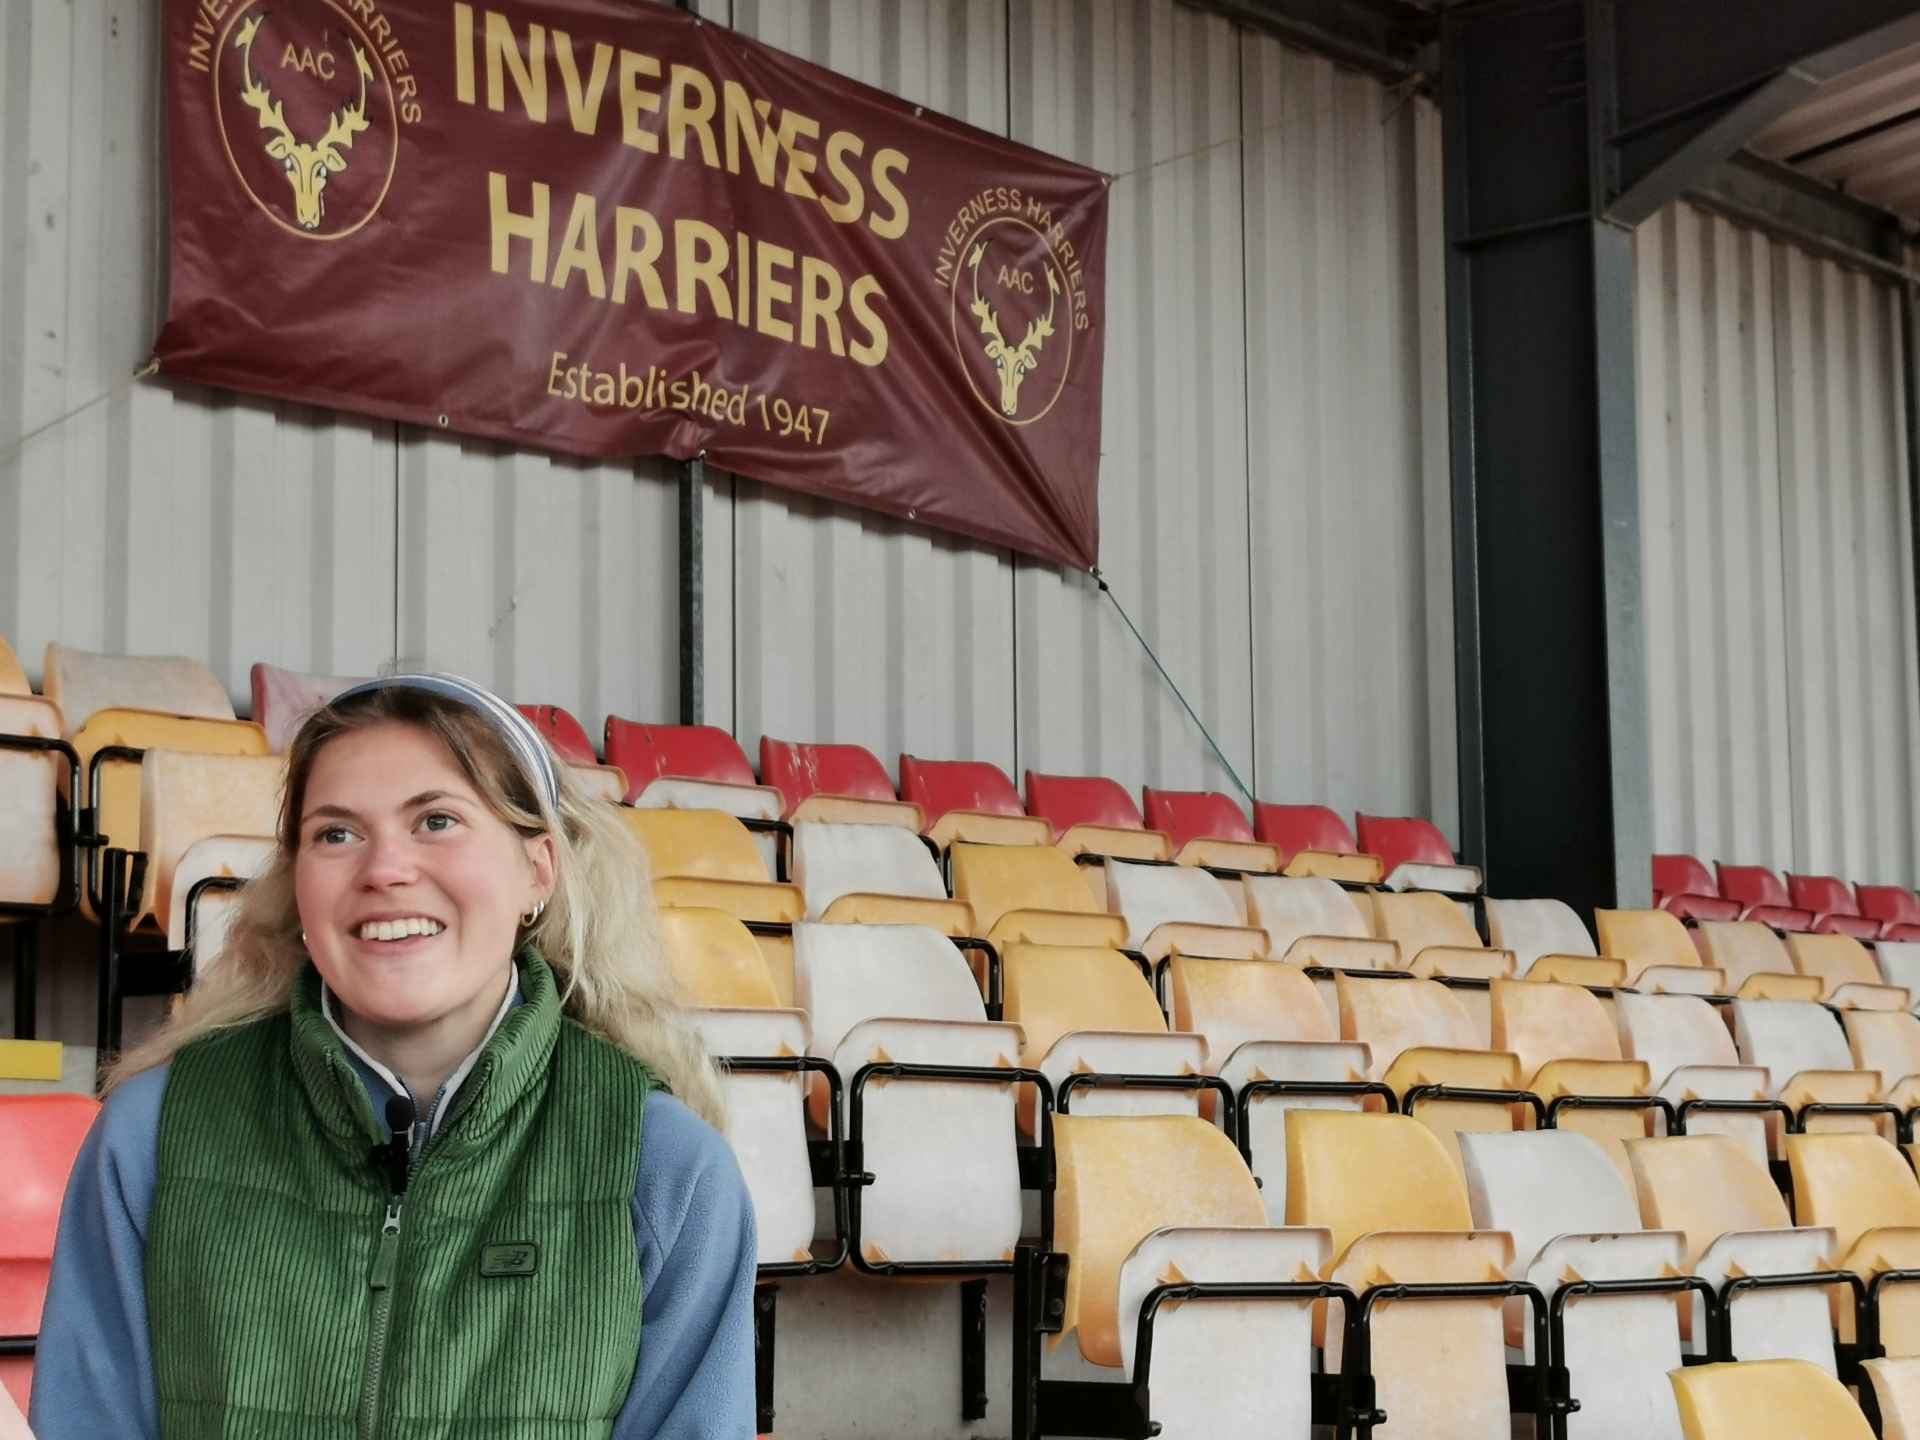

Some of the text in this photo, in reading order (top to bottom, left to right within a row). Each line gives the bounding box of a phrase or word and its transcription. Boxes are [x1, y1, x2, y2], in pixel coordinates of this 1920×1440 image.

[281, 42, 335, 79] AAC
[348, 0, 422, 124] RRIERS
[454, 2, 909, 240] INVERNESS
[489, 171, 889, 368] HARRIERS
[935, 187, 1089, 330] INVERNESS HARRIERS
[997, 265, 1034, 294] AAC
[547, 351, 829, 445] Established 1947
